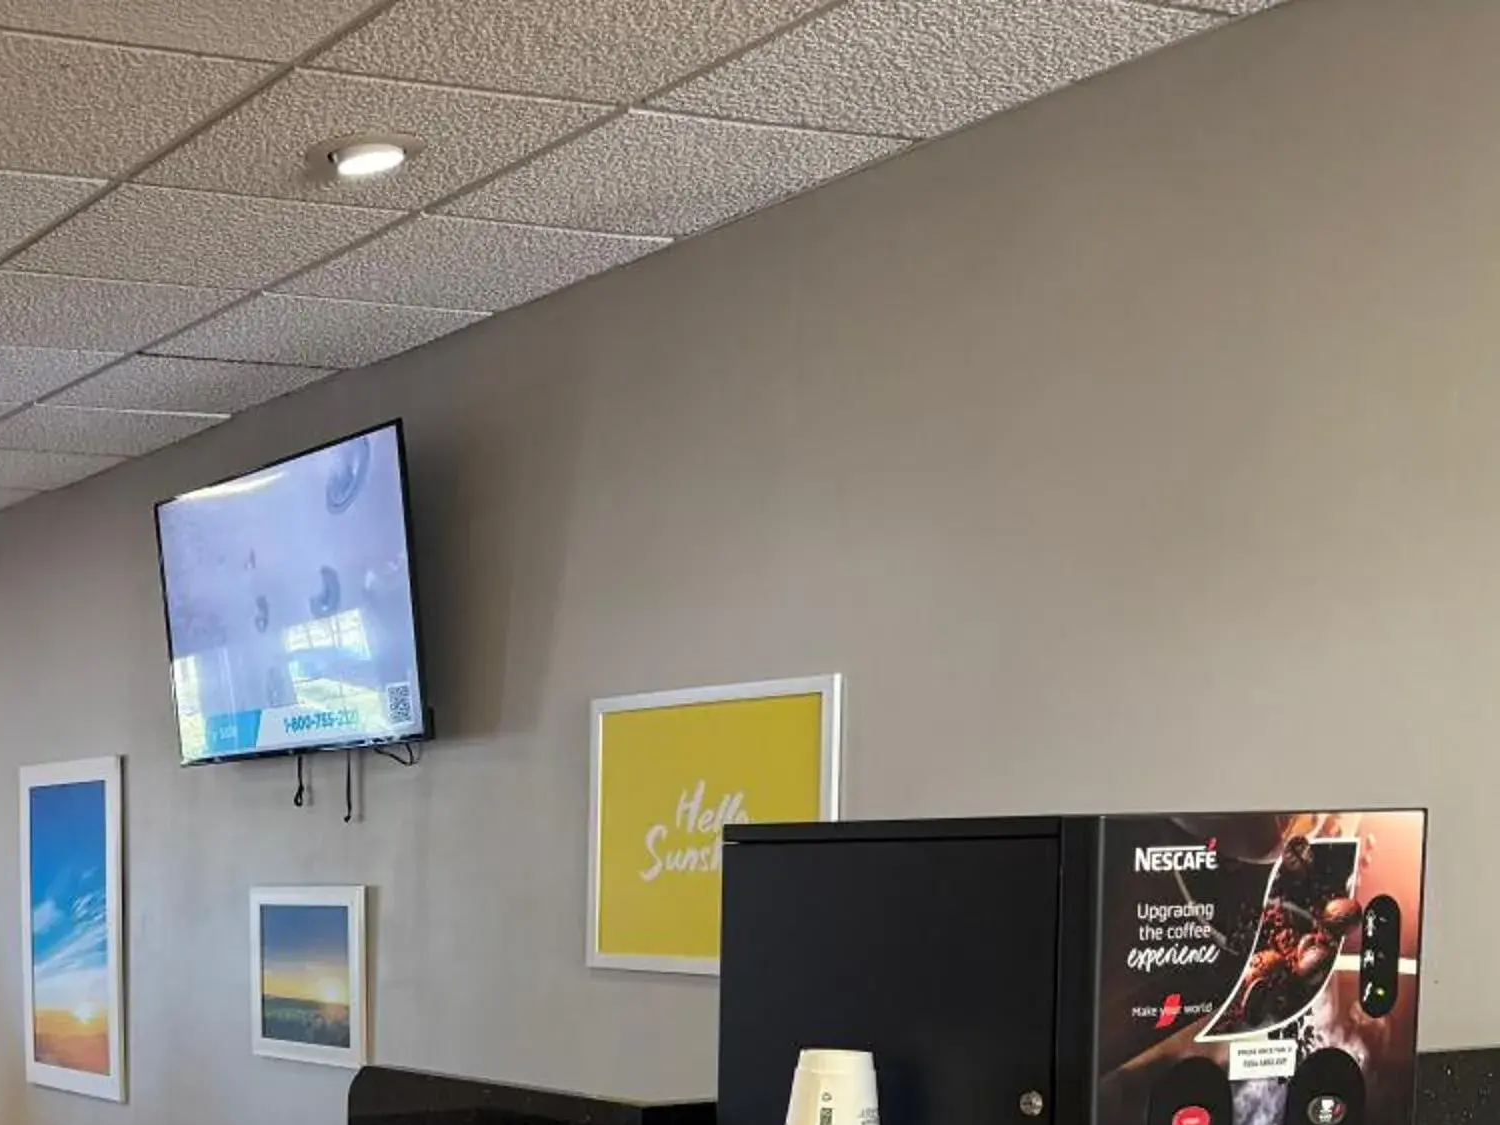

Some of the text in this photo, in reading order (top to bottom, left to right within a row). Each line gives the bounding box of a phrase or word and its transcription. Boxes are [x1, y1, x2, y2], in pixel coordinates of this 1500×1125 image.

[676, 779, 751, 834] Hello
[1137, 903, 1214, 922] Upgrading
[1139, 921, 1211, 940] the coffee
[1127, 943, 1220, 972] experience
[1132, 1006, 1157, 1017] Make
[1184, 1002, 1213, 1014] world
